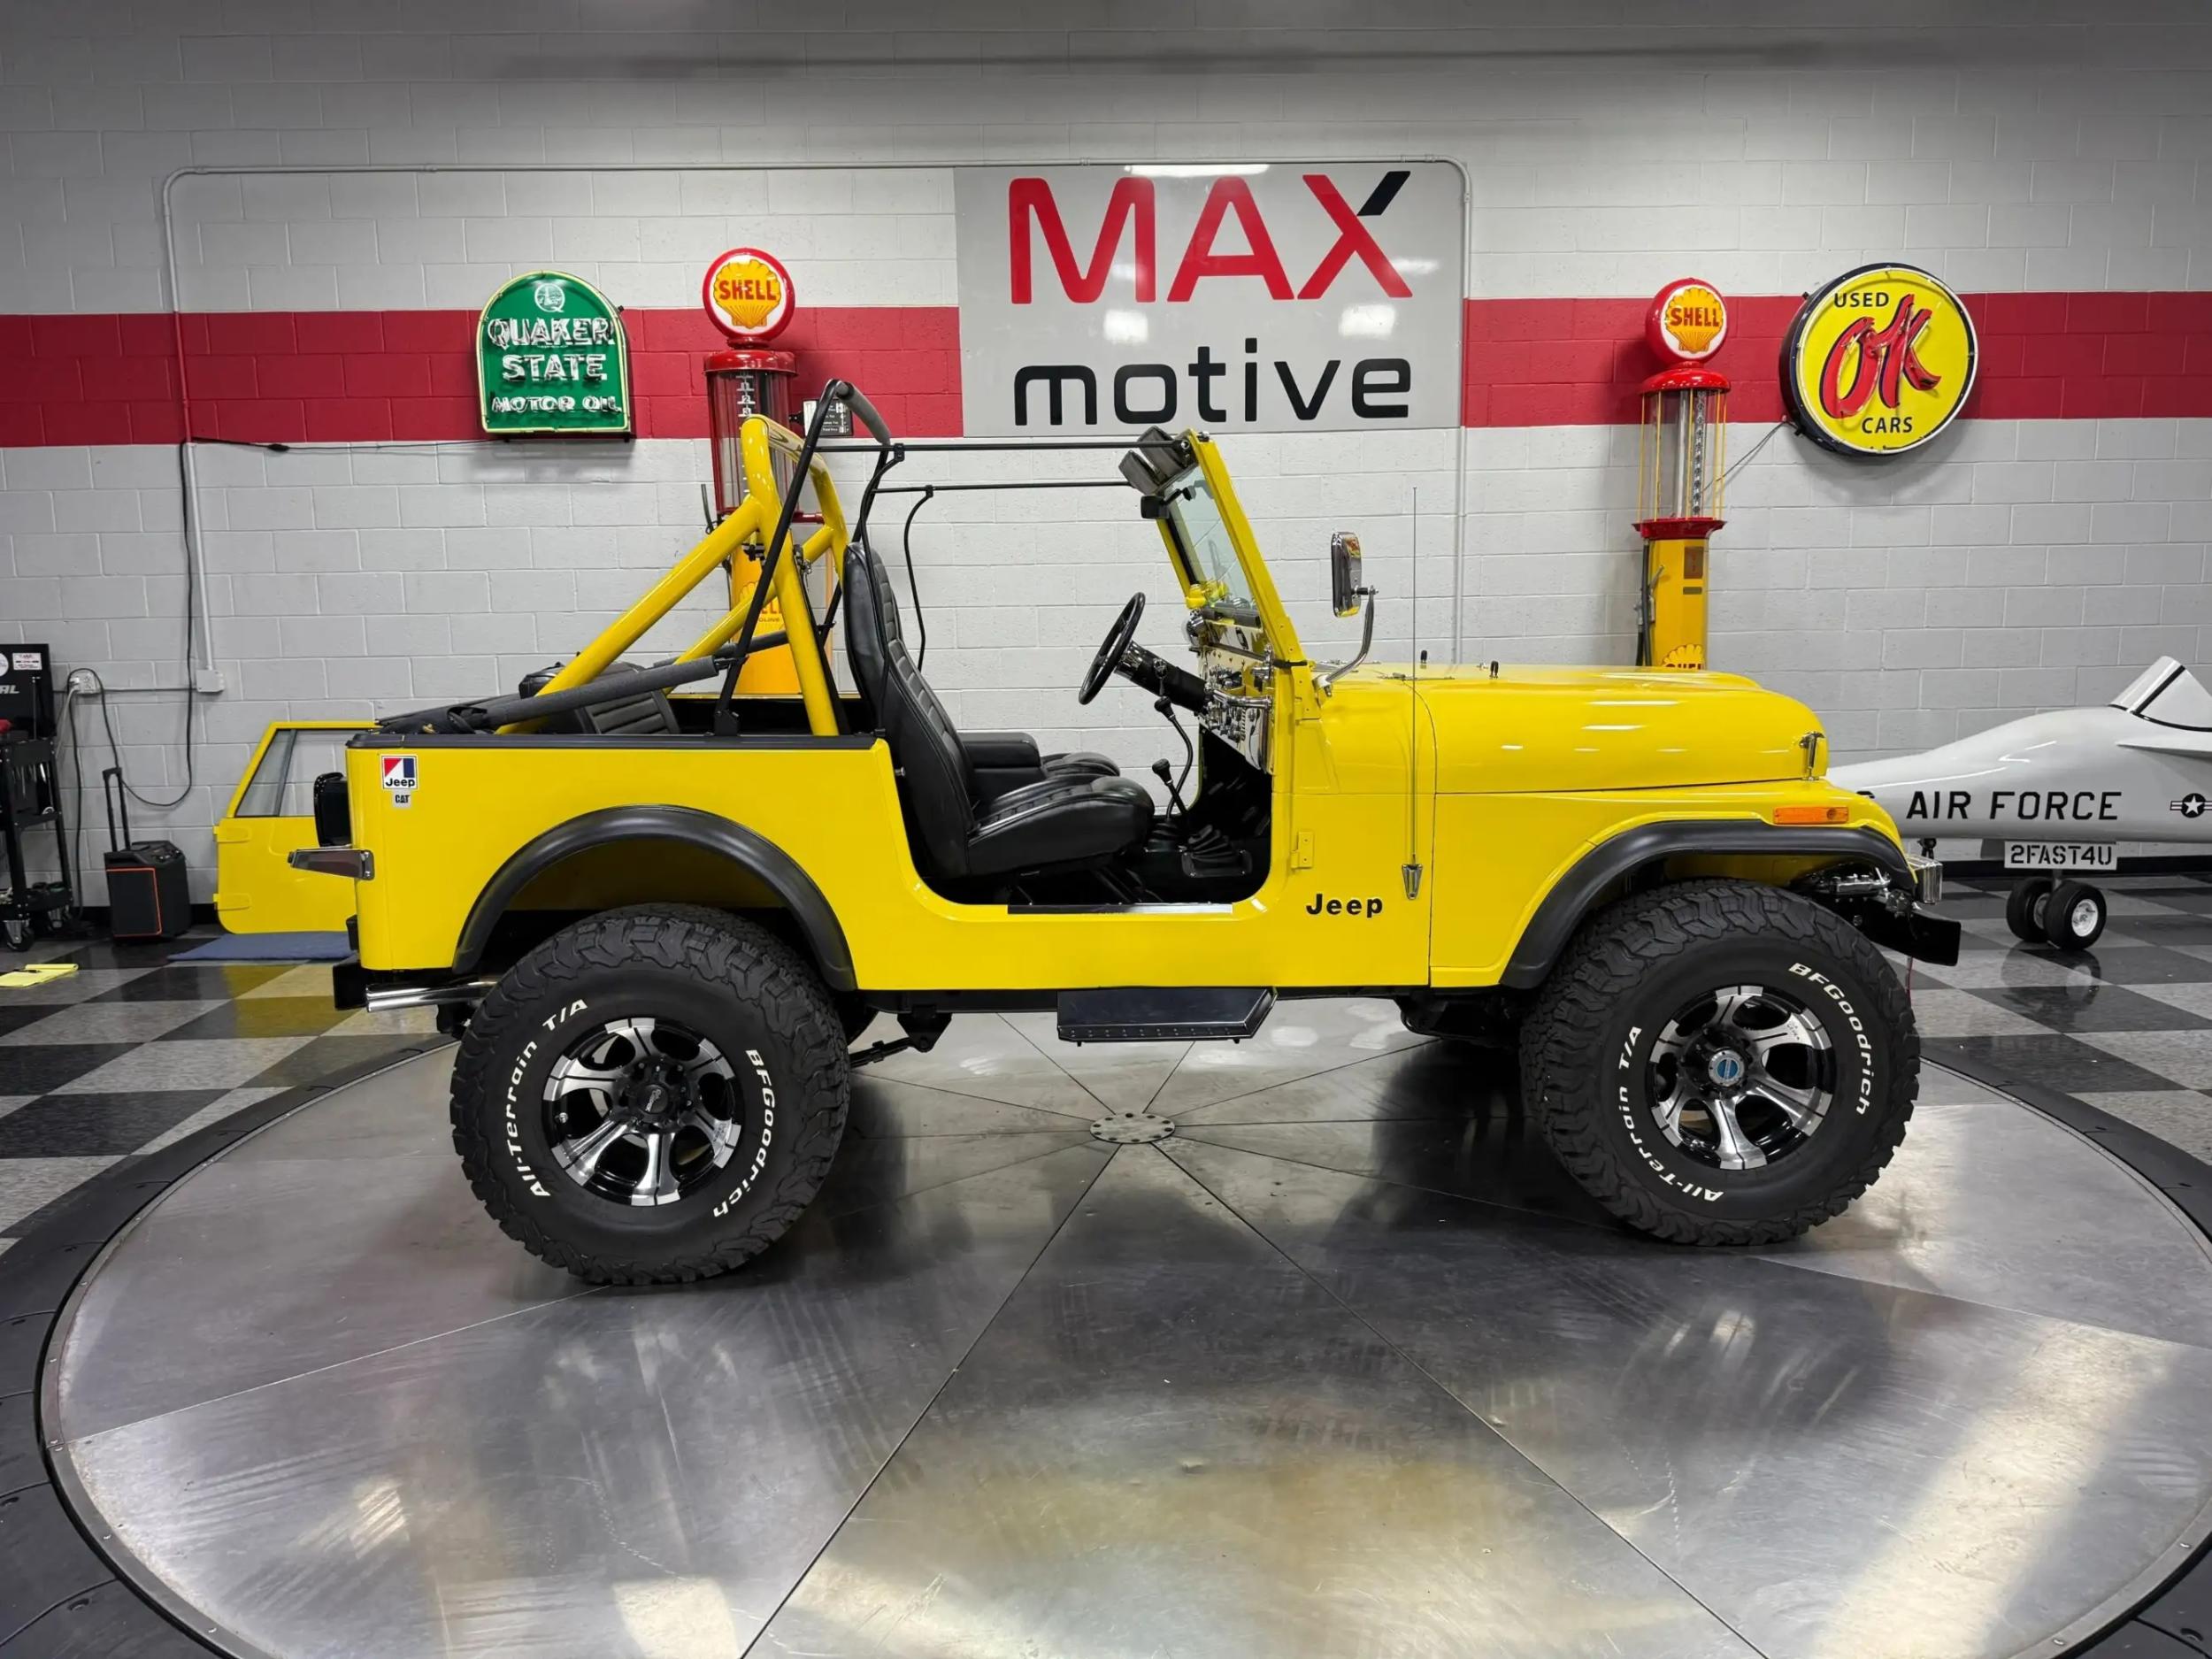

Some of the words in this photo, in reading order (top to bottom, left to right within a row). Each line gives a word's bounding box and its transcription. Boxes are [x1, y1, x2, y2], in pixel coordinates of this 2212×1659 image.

[1009, 171, 1413, 304] MAX
[718, 279, 777, 301] SHELL
[1834, 292, 1889, 308] USED
[1670, 306, 1719, 327] SHELL
[488, 317, 616, 350] QUAKER
[502, 354, 608, 381] STATE
[1819, 294, 1941, 419] OK
[1014, 337, 1411, 426] motive
[491, 396, 575, 413] MOTOR
[582, 396, 622, 413] OIL
[1862, 416, 1913, 434] CARS
[385, 778, 416, 788] Jeep
[395, 794, 411, 803] CAT
[1906, 791, 1972, 820] AIR
[1989, 791, 2122, 821] FORCE
[2010, 844, 2113, 865] 2FAST4U
[1306, 893, 1383, 918] Jeep
[1618, 1026, 1642, 1070] T/A
[1788, 963, 1875, 1116] BFGoodrich
[505, 1041, 552, 1197] All-Terrain
[541, 998, 588, 1032] T/A
[712, 1048, 775, 1217] BFGoodrich
[1618, 1086, 1725, 1202] All-Terrain
